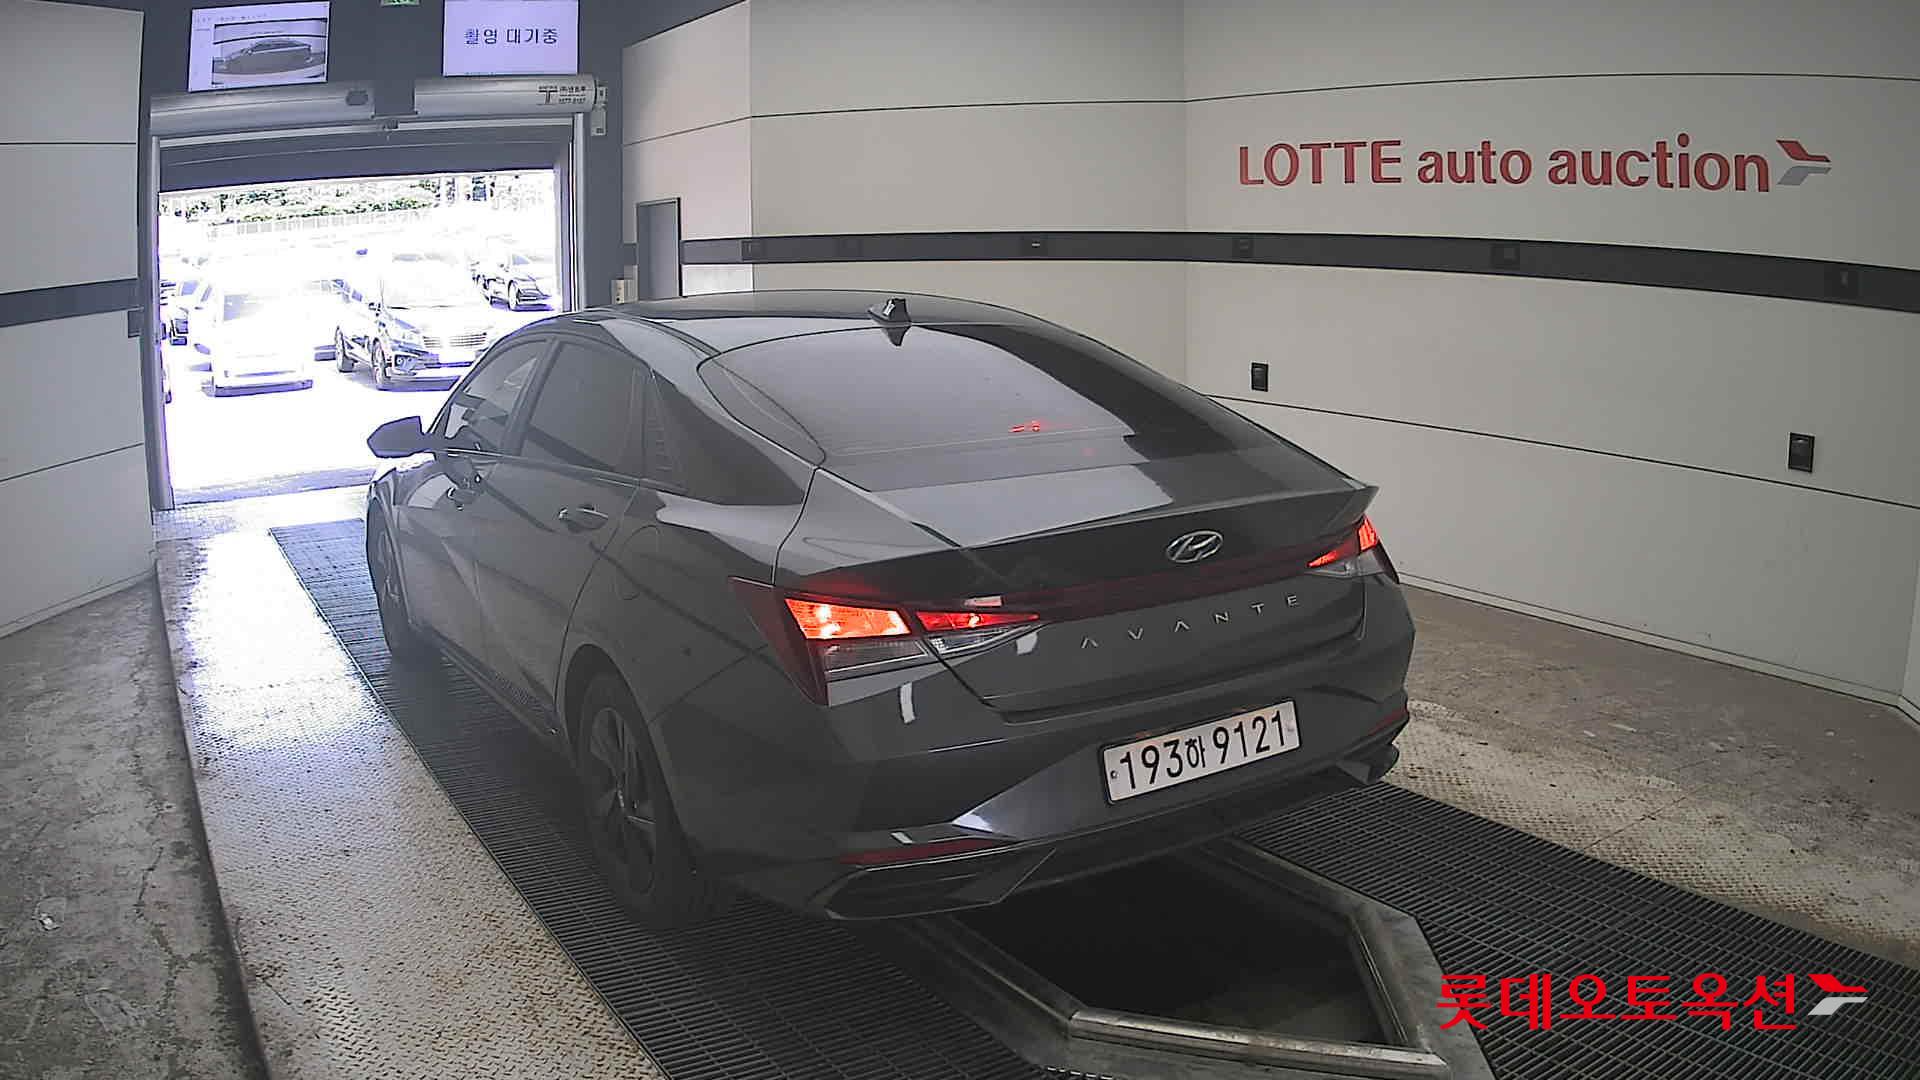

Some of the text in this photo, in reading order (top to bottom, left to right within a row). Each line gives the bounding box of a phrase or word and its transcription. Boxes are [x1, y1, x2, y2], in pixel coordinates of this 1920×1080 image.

[506, 28, 558, 44] 대기중
[1239, 133, 1769, 193] LOTTE auto auction
[1081, 595, 1298, 648] AVANTE
[1120, 710, 1285, 789] 193하 9121
